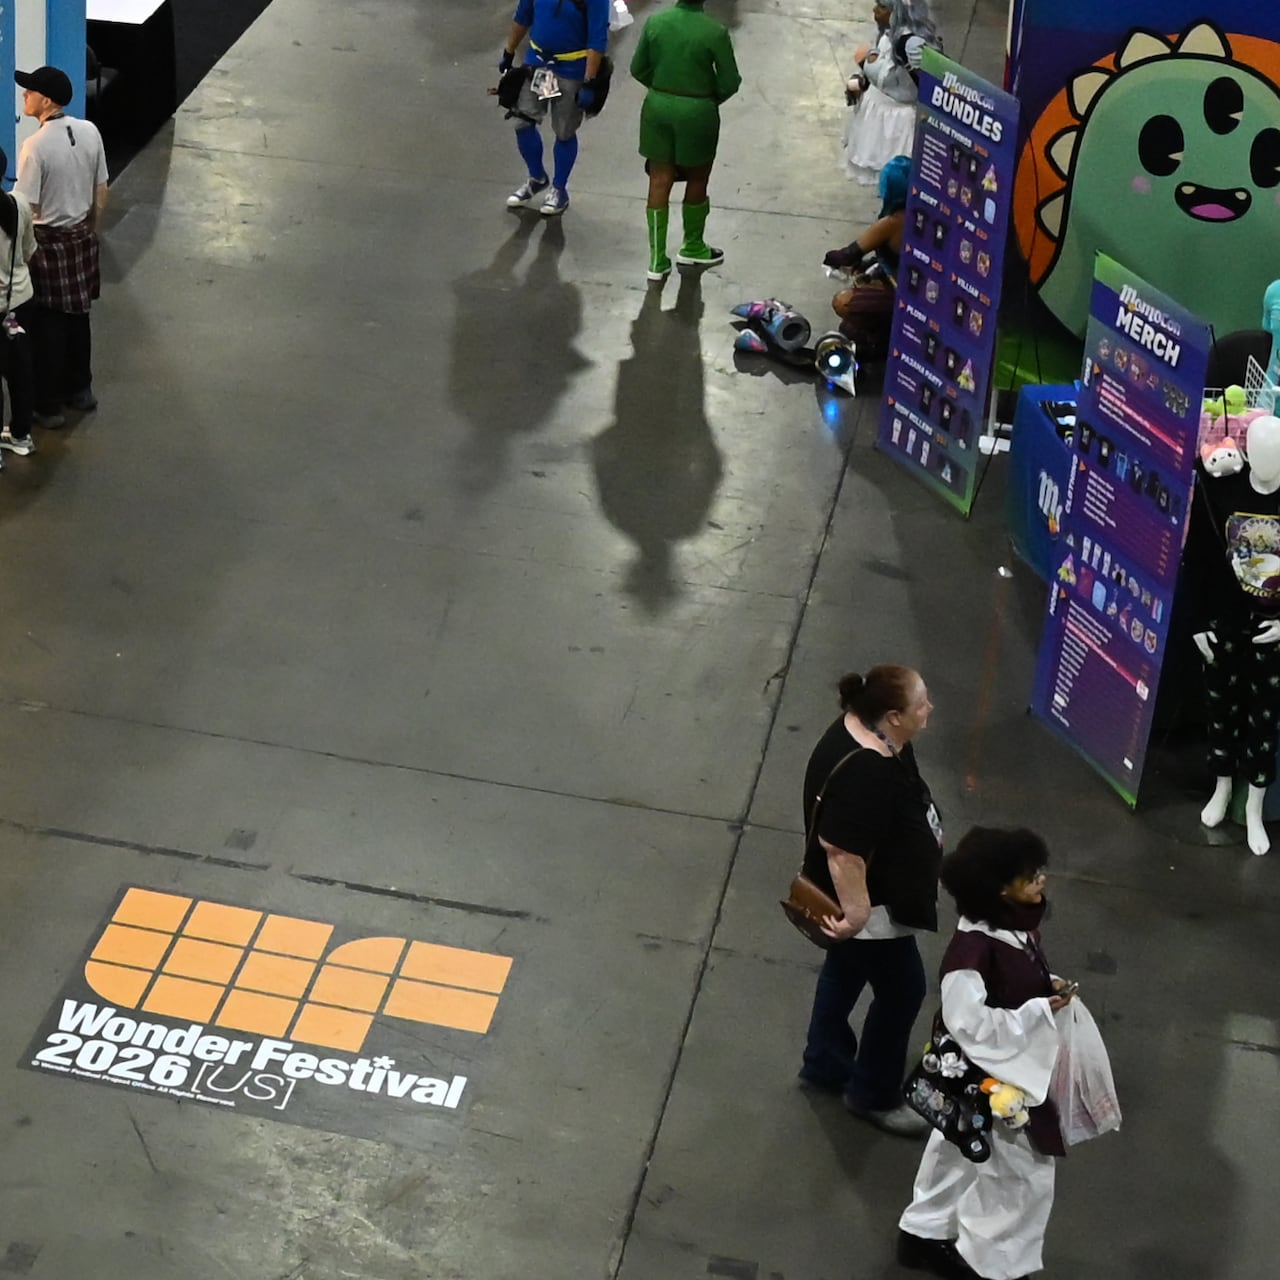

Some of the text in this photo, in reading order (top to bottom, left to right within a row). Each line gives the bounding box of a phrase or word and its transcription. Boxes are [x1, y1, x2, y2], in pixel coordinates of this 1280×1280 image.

[931, 85, 1003, 142] BUNDLES
[1116, 306, 1181, 367] MERCH
[1120, 284, 1181, 336] MomoCon
[35, 1032, 297, 1110] 2026 [US]
[58, 998, 467, 1109] Wonder Festival
